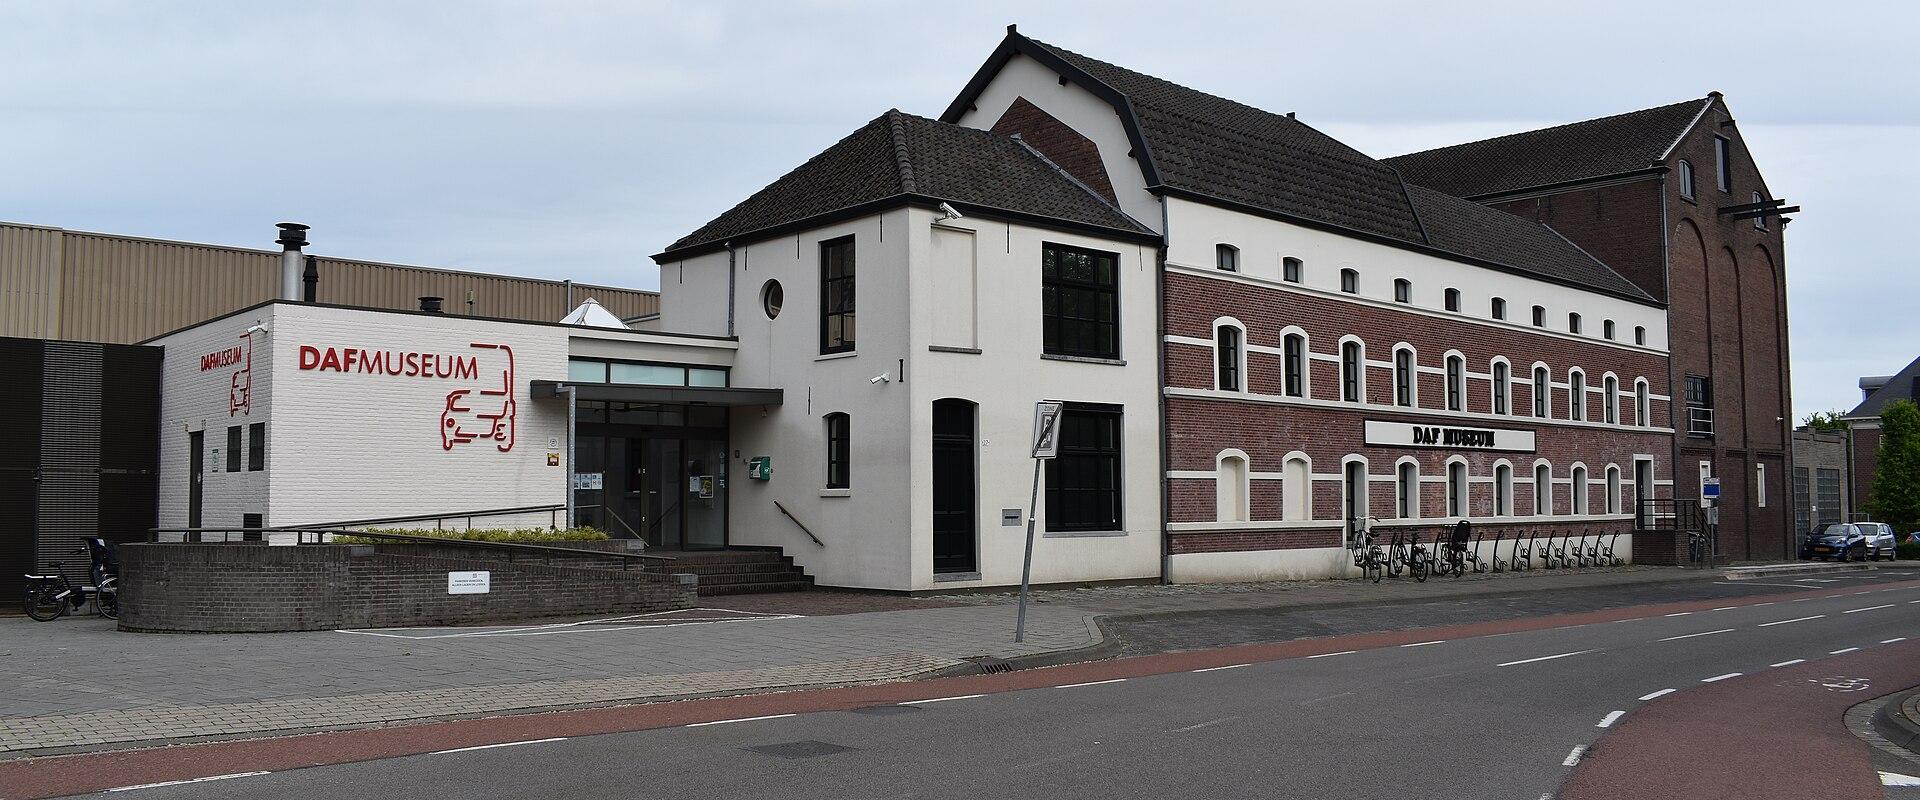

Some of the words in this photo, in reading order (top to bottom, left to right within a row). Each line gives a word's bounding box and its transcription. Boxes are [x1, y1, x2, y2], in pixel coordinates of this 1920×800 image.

[201, 346, 242, 371] DAFMUSEUM
[1413, 426, 1440, 444] DAF
[1443, 428, 1495, 447] MUSEUM
